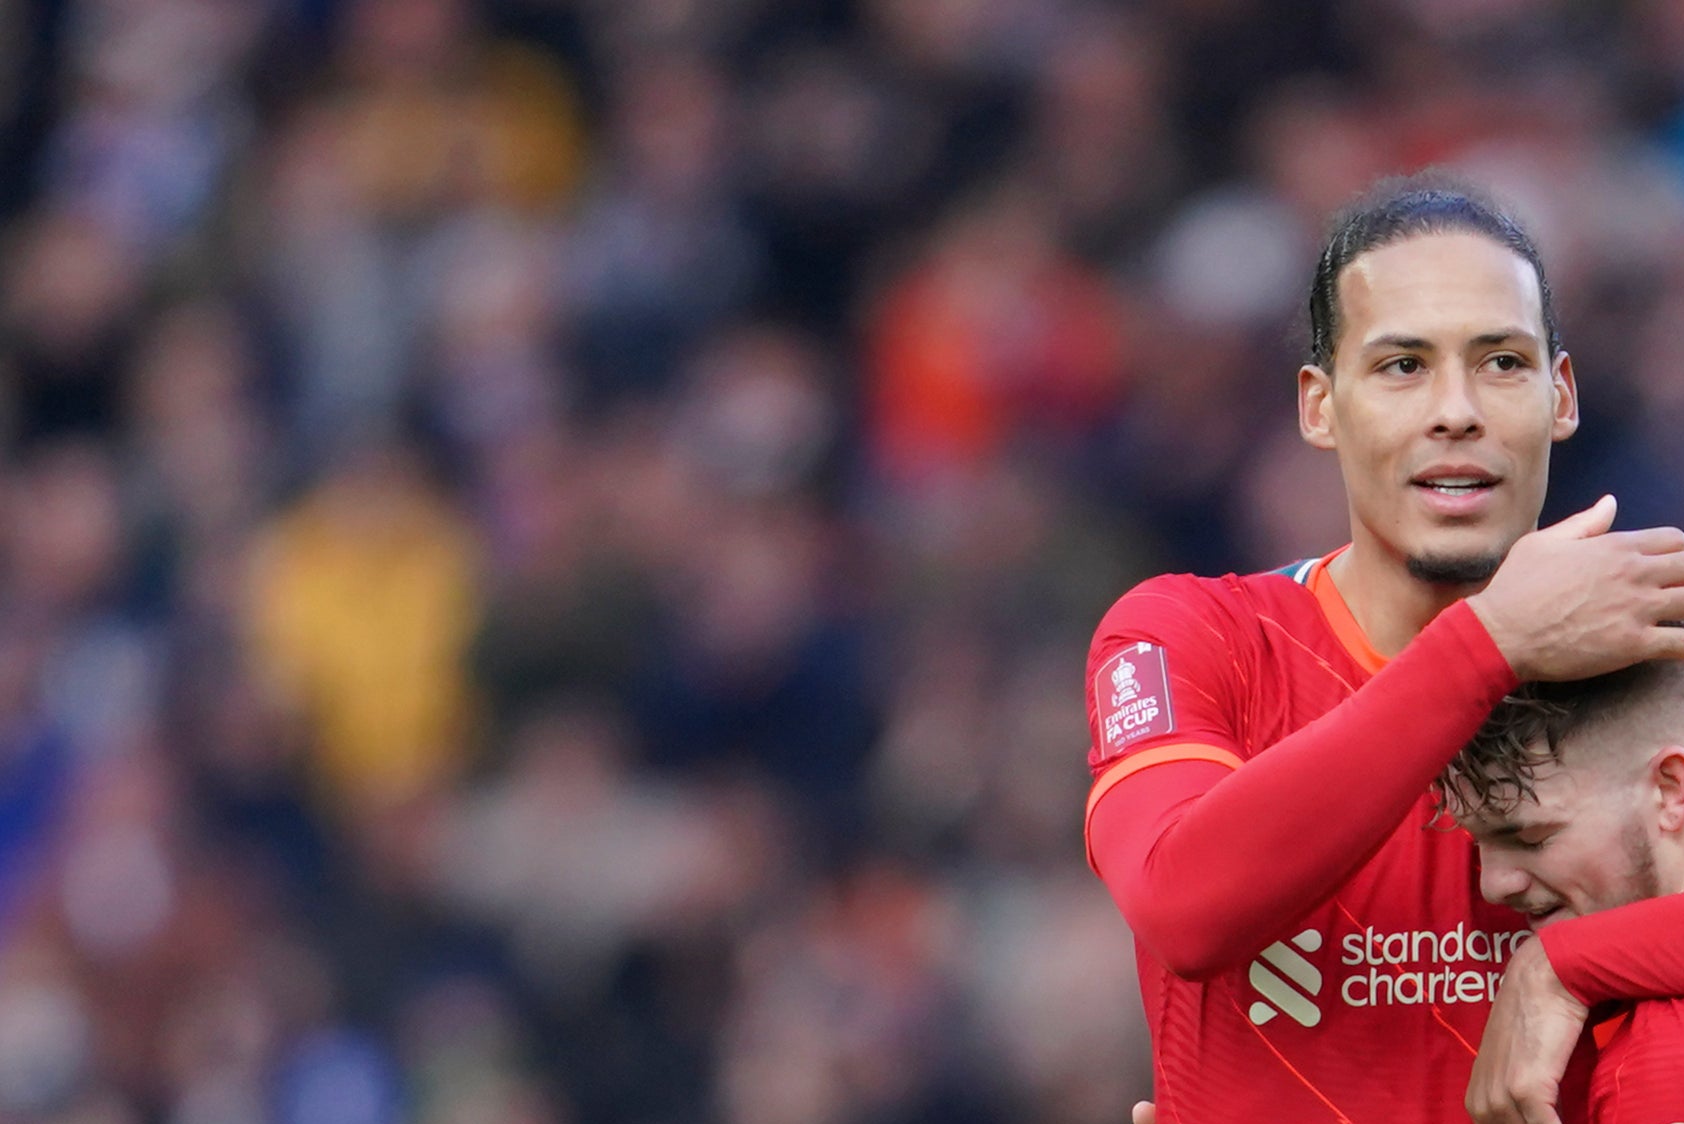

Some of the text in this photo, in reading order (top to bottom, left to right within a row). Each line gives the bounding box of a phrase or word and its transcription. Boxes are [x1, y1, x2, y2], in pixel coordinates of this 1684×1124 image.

[1105, 696, 1157, 729] Emirates
[1107, 724, 1122, 743] FA
[1123, 707, 1159, 730] CUP
[1341, 966, 1505, 1007] charter
